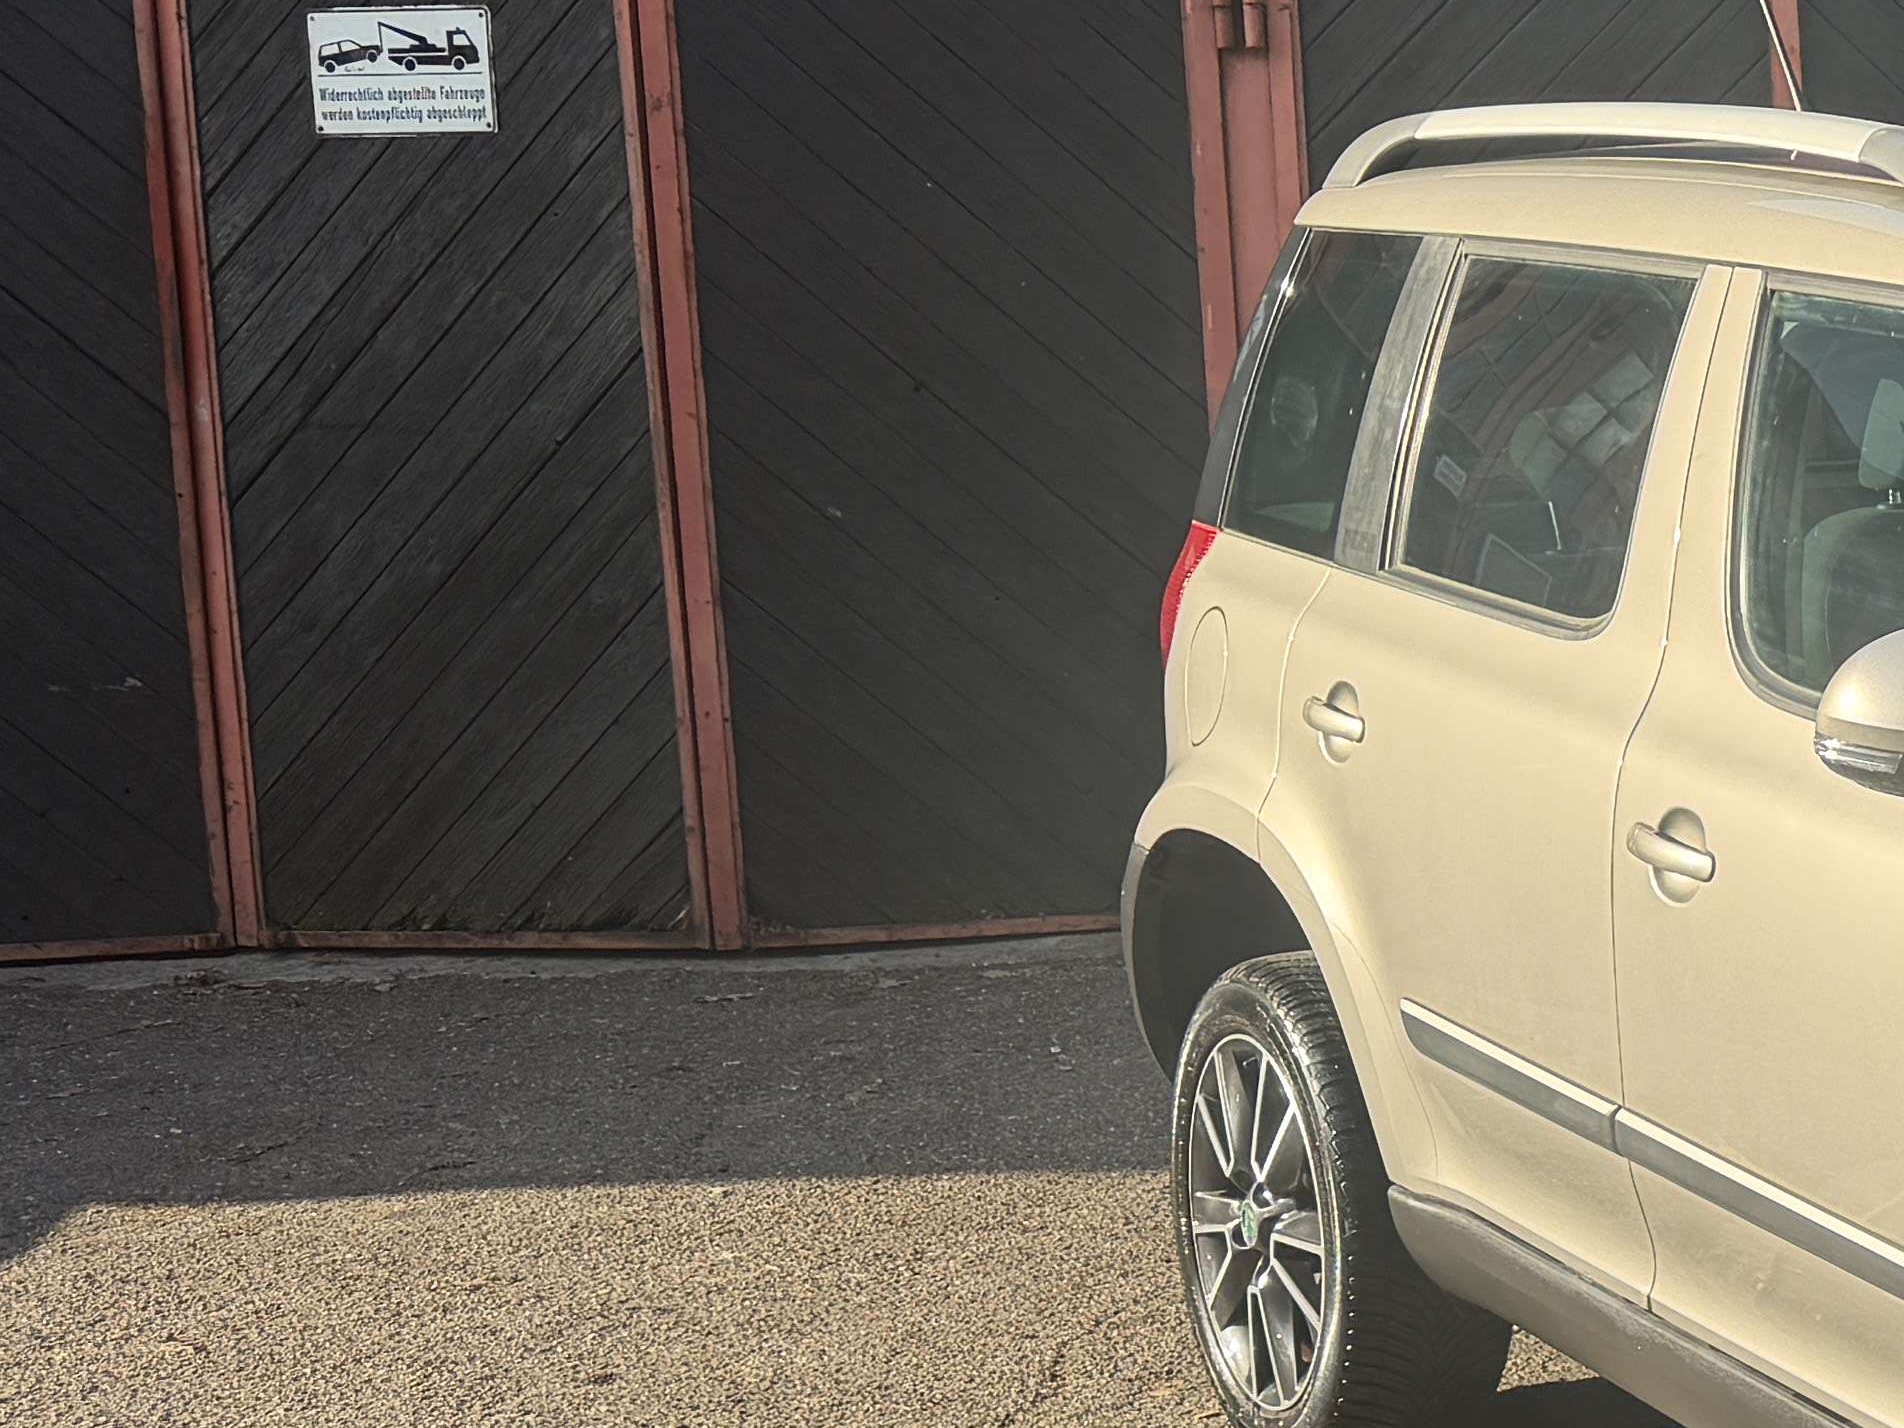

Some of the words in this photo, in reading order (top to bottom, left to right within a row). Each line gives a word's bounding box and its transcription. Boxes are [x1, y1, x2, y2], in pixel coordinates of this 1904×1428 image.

[318, 87, 384, 102] Widerrechtlich
[387, 86, 436, 104] abgestellte
[440, 85, 485, 103] Fahrzeuge
[321, 107, 354, 121] werden
[356, 106, 423, 124] kostenpflichtig
[426, 105, 487, 122] abgeschleppt
